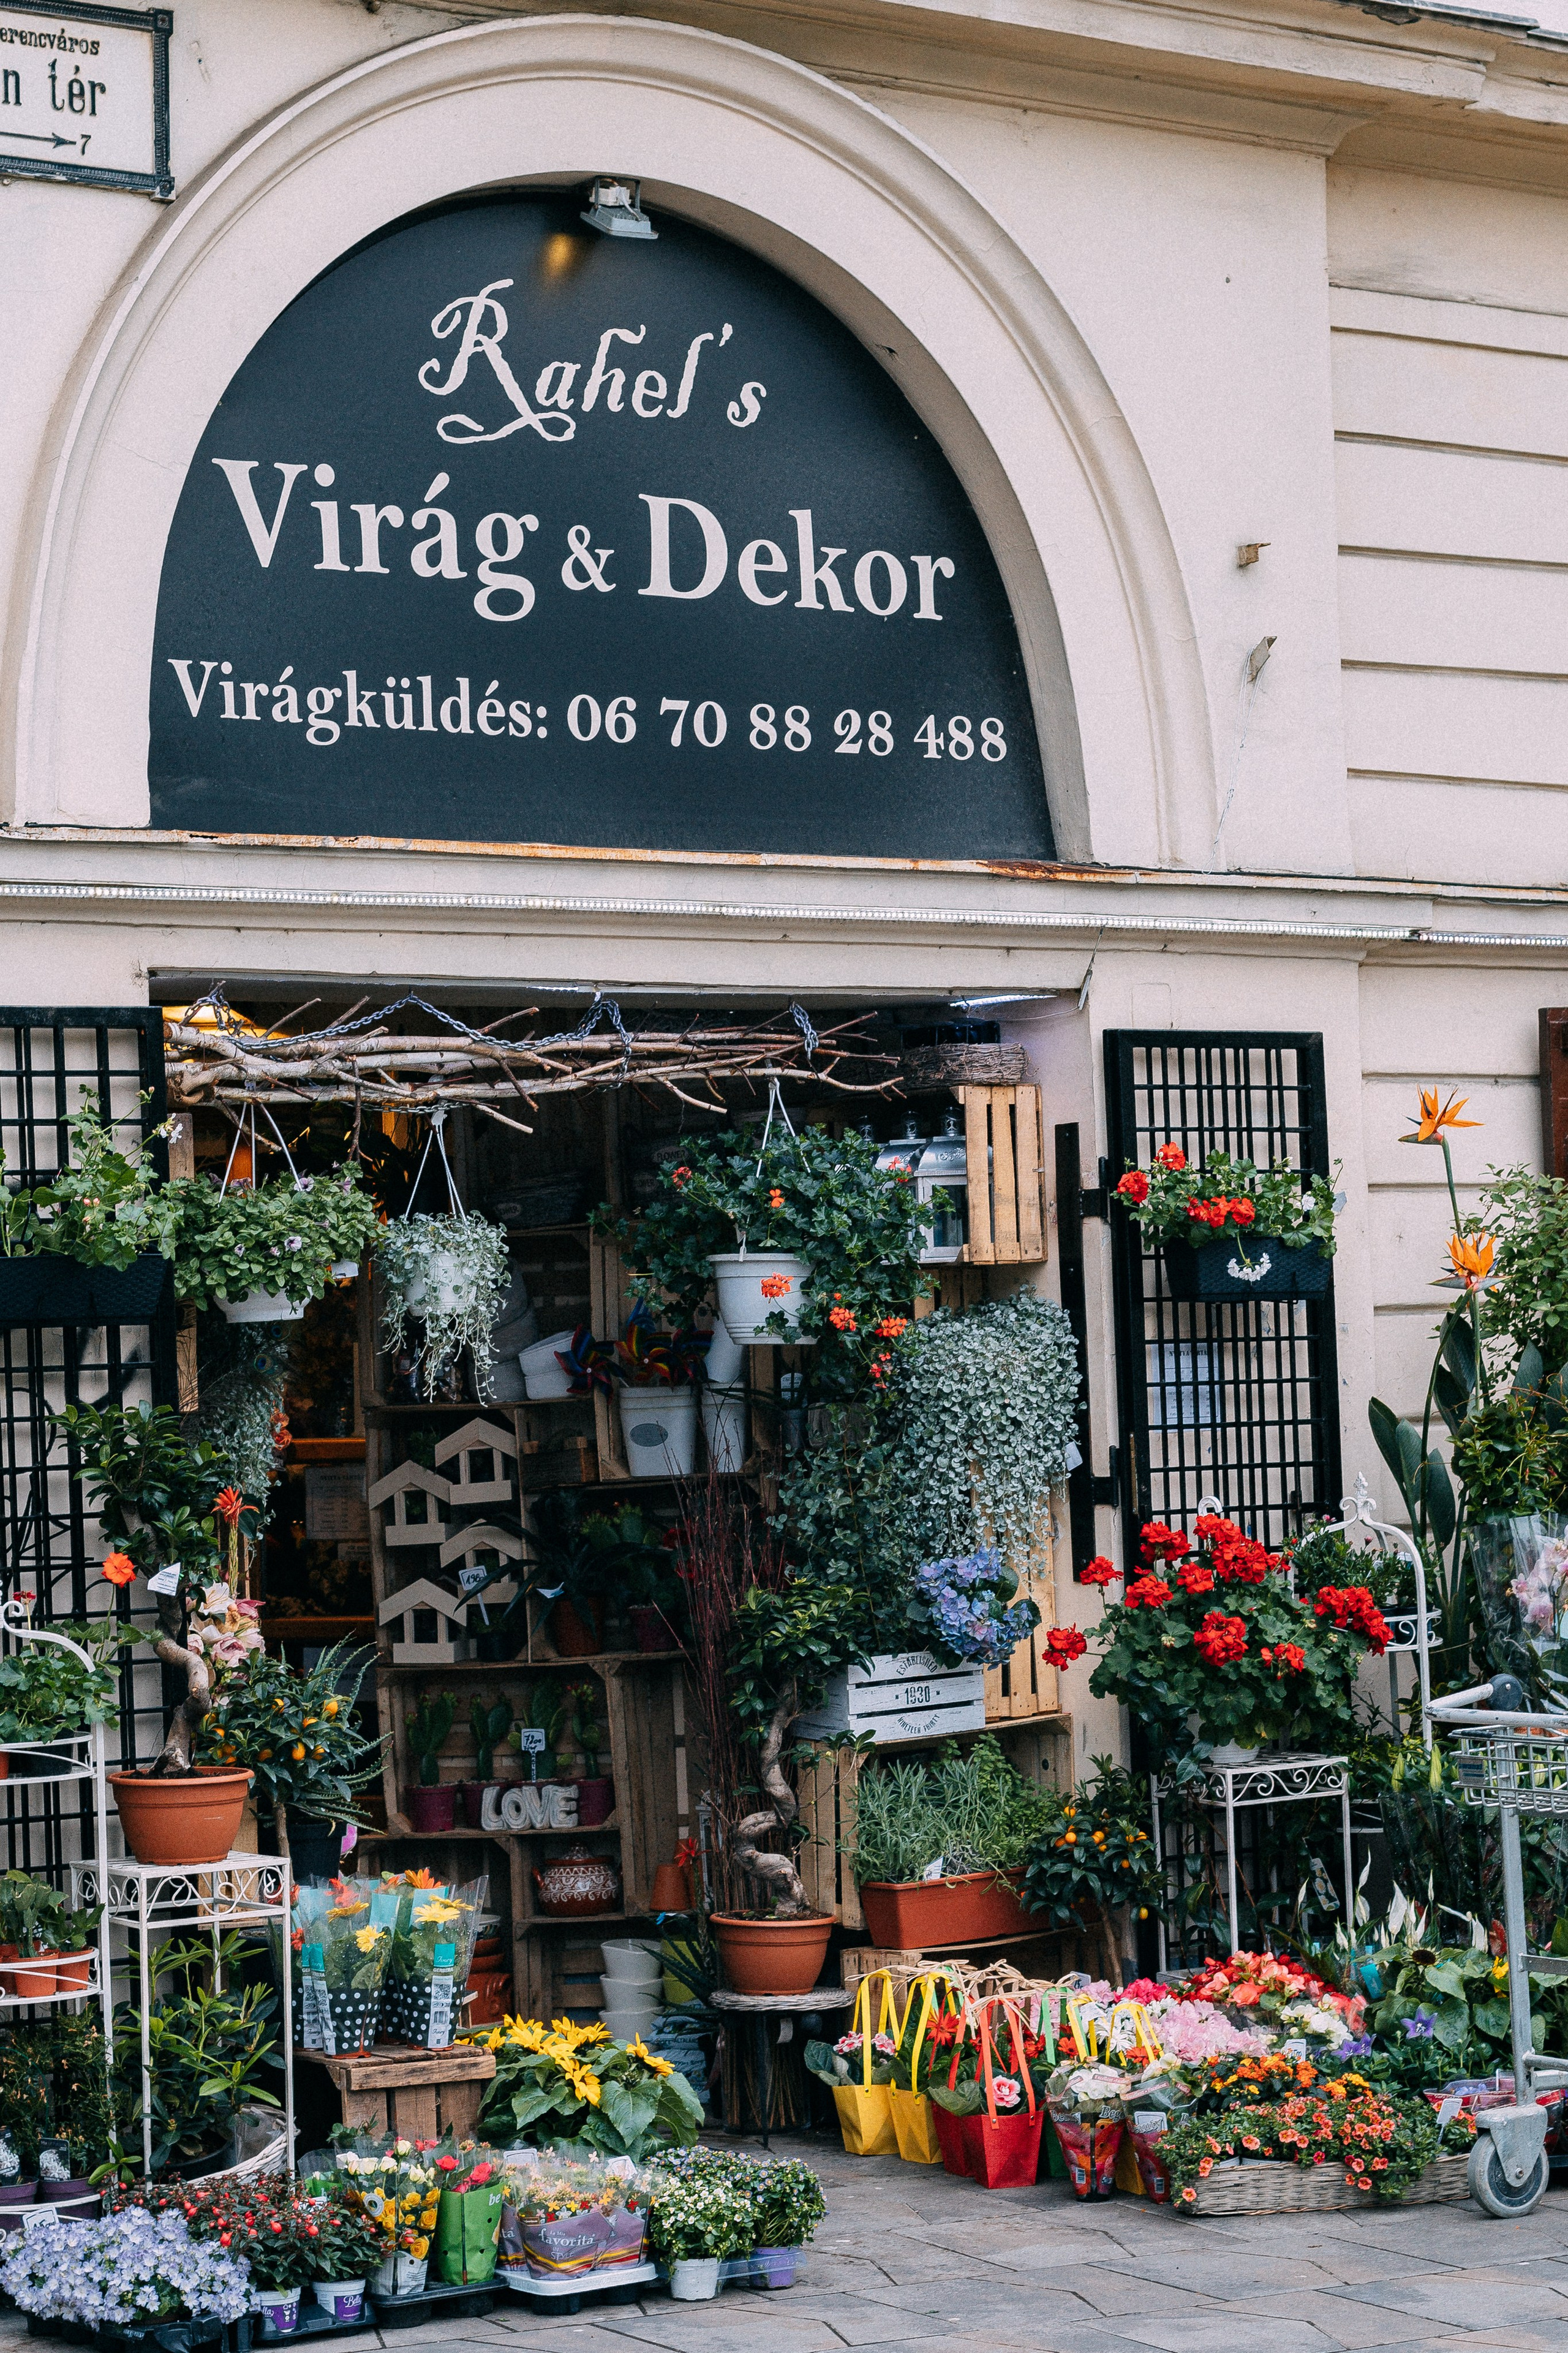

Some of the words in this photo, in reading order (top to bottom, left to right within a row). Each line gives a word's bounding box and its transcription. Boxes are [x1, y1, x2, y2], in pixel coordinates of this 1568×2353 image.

[48, 58, 107, 116] tér
[80, 134, 91, 155] 7
[418, 279, 766, 444] Rahel's
[212, 458, 539, 622] Virág
[561, 525, 616, 592] &
[638, 493, 956, 621] Dekor
[168, 657, 548, 746] Virágküldés:
[567, 694, 636, 743] 06
[660, 697, 727, 747] 70
[749, 703, 812, 752] 88
[834, 709, 894, 756] 28
[914, 714, 1007, 762] 488
[896, 1655, 937, 1675] ESTABLISHED
[905, 1686, 930, 1704] 1930
[897, 1717, 921, 1734] NINETEEN
[923, 1714, 940, 1732] THIRTY
[481, 1785, 579, 1831] LOVE
[437, 1955, 453, 1964] Ivory
